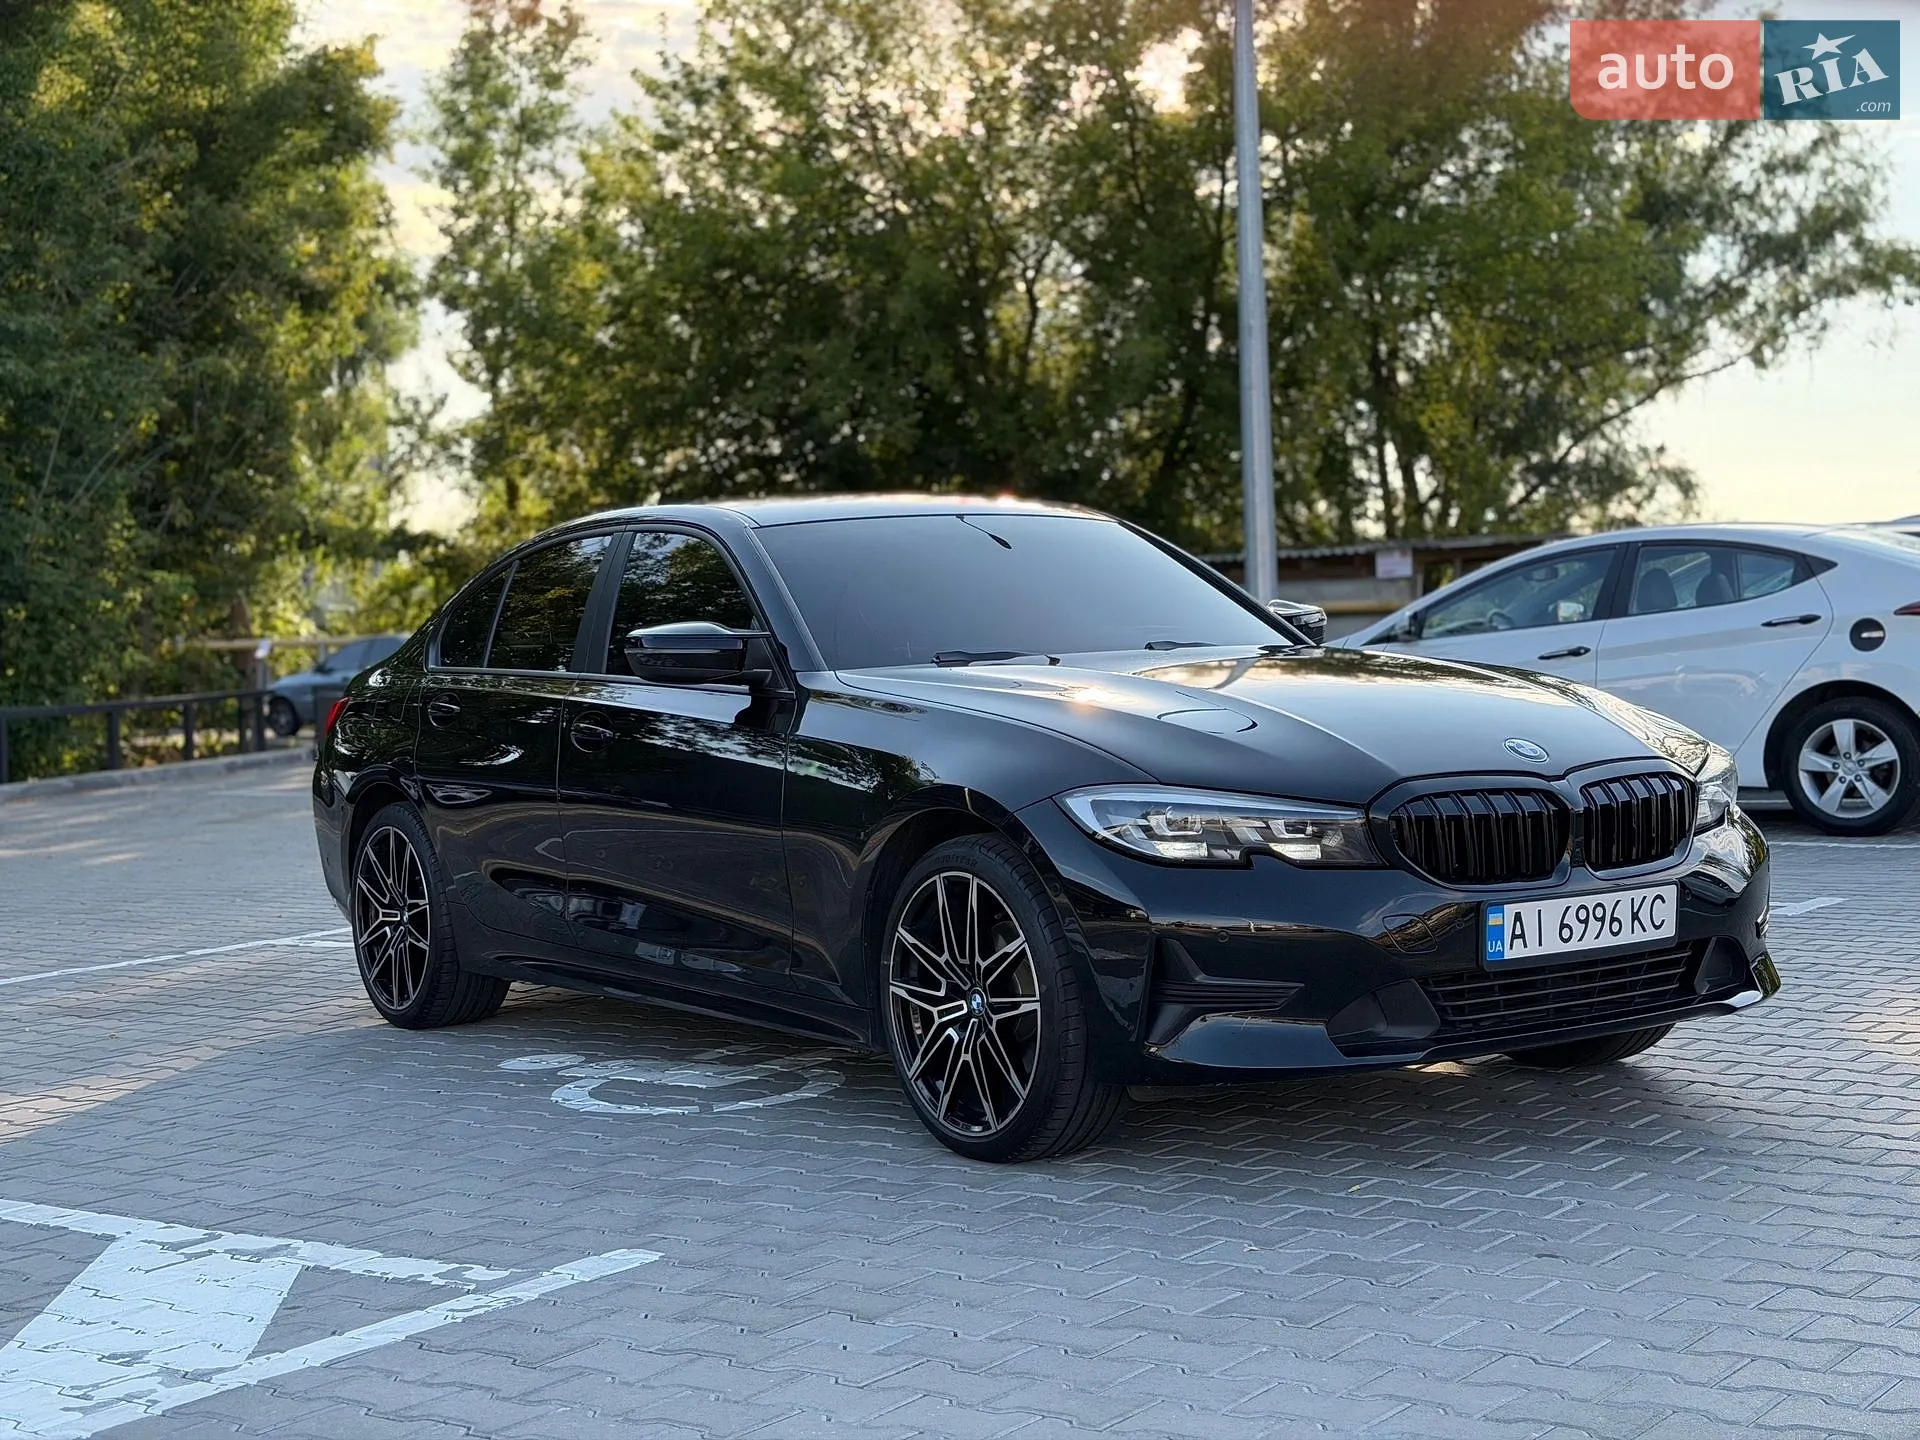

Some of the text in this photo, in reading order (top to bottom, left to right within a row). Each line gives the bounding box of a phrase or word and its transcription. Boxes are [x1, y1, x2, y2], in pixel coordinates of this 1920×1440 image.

[1509, 893, 1667, 950] AI 6996 KC
[1488, 941, 1503, 953] UA
